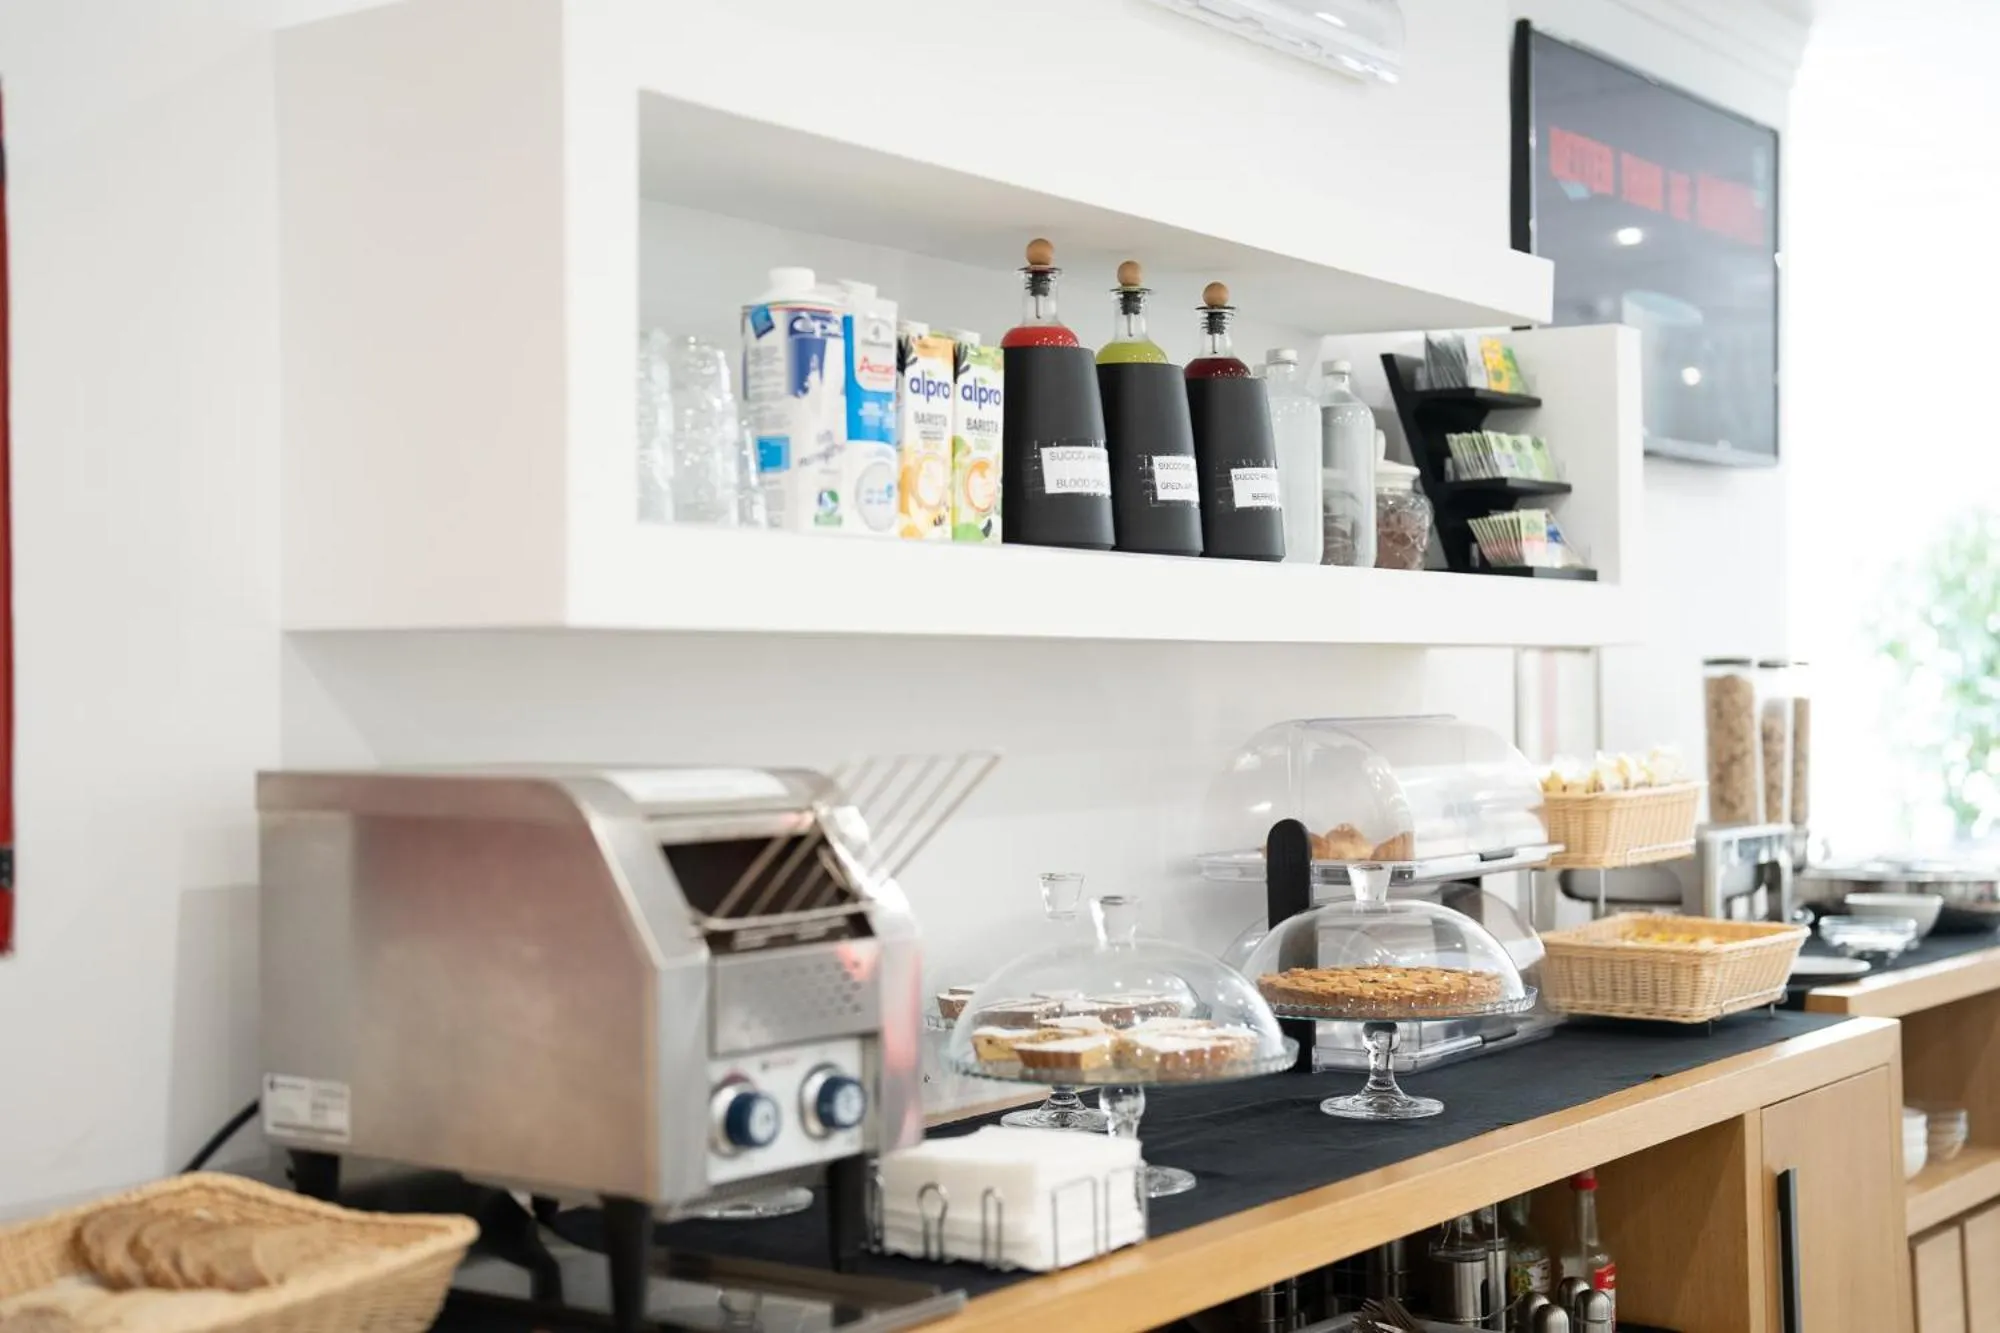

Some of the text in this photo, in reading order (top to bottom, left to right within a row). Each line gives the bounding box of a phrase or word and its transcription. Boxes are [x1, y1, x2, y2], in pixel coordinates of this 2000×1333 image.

[909, 369, 951, 404] alpro
[961, 377, 1002, 410] alpro
[966, 417, 999, 433] BARISTA
[1049, 450, 1086, 461] SUCCO
[1055, 477, 1089, 489] BLOOD
